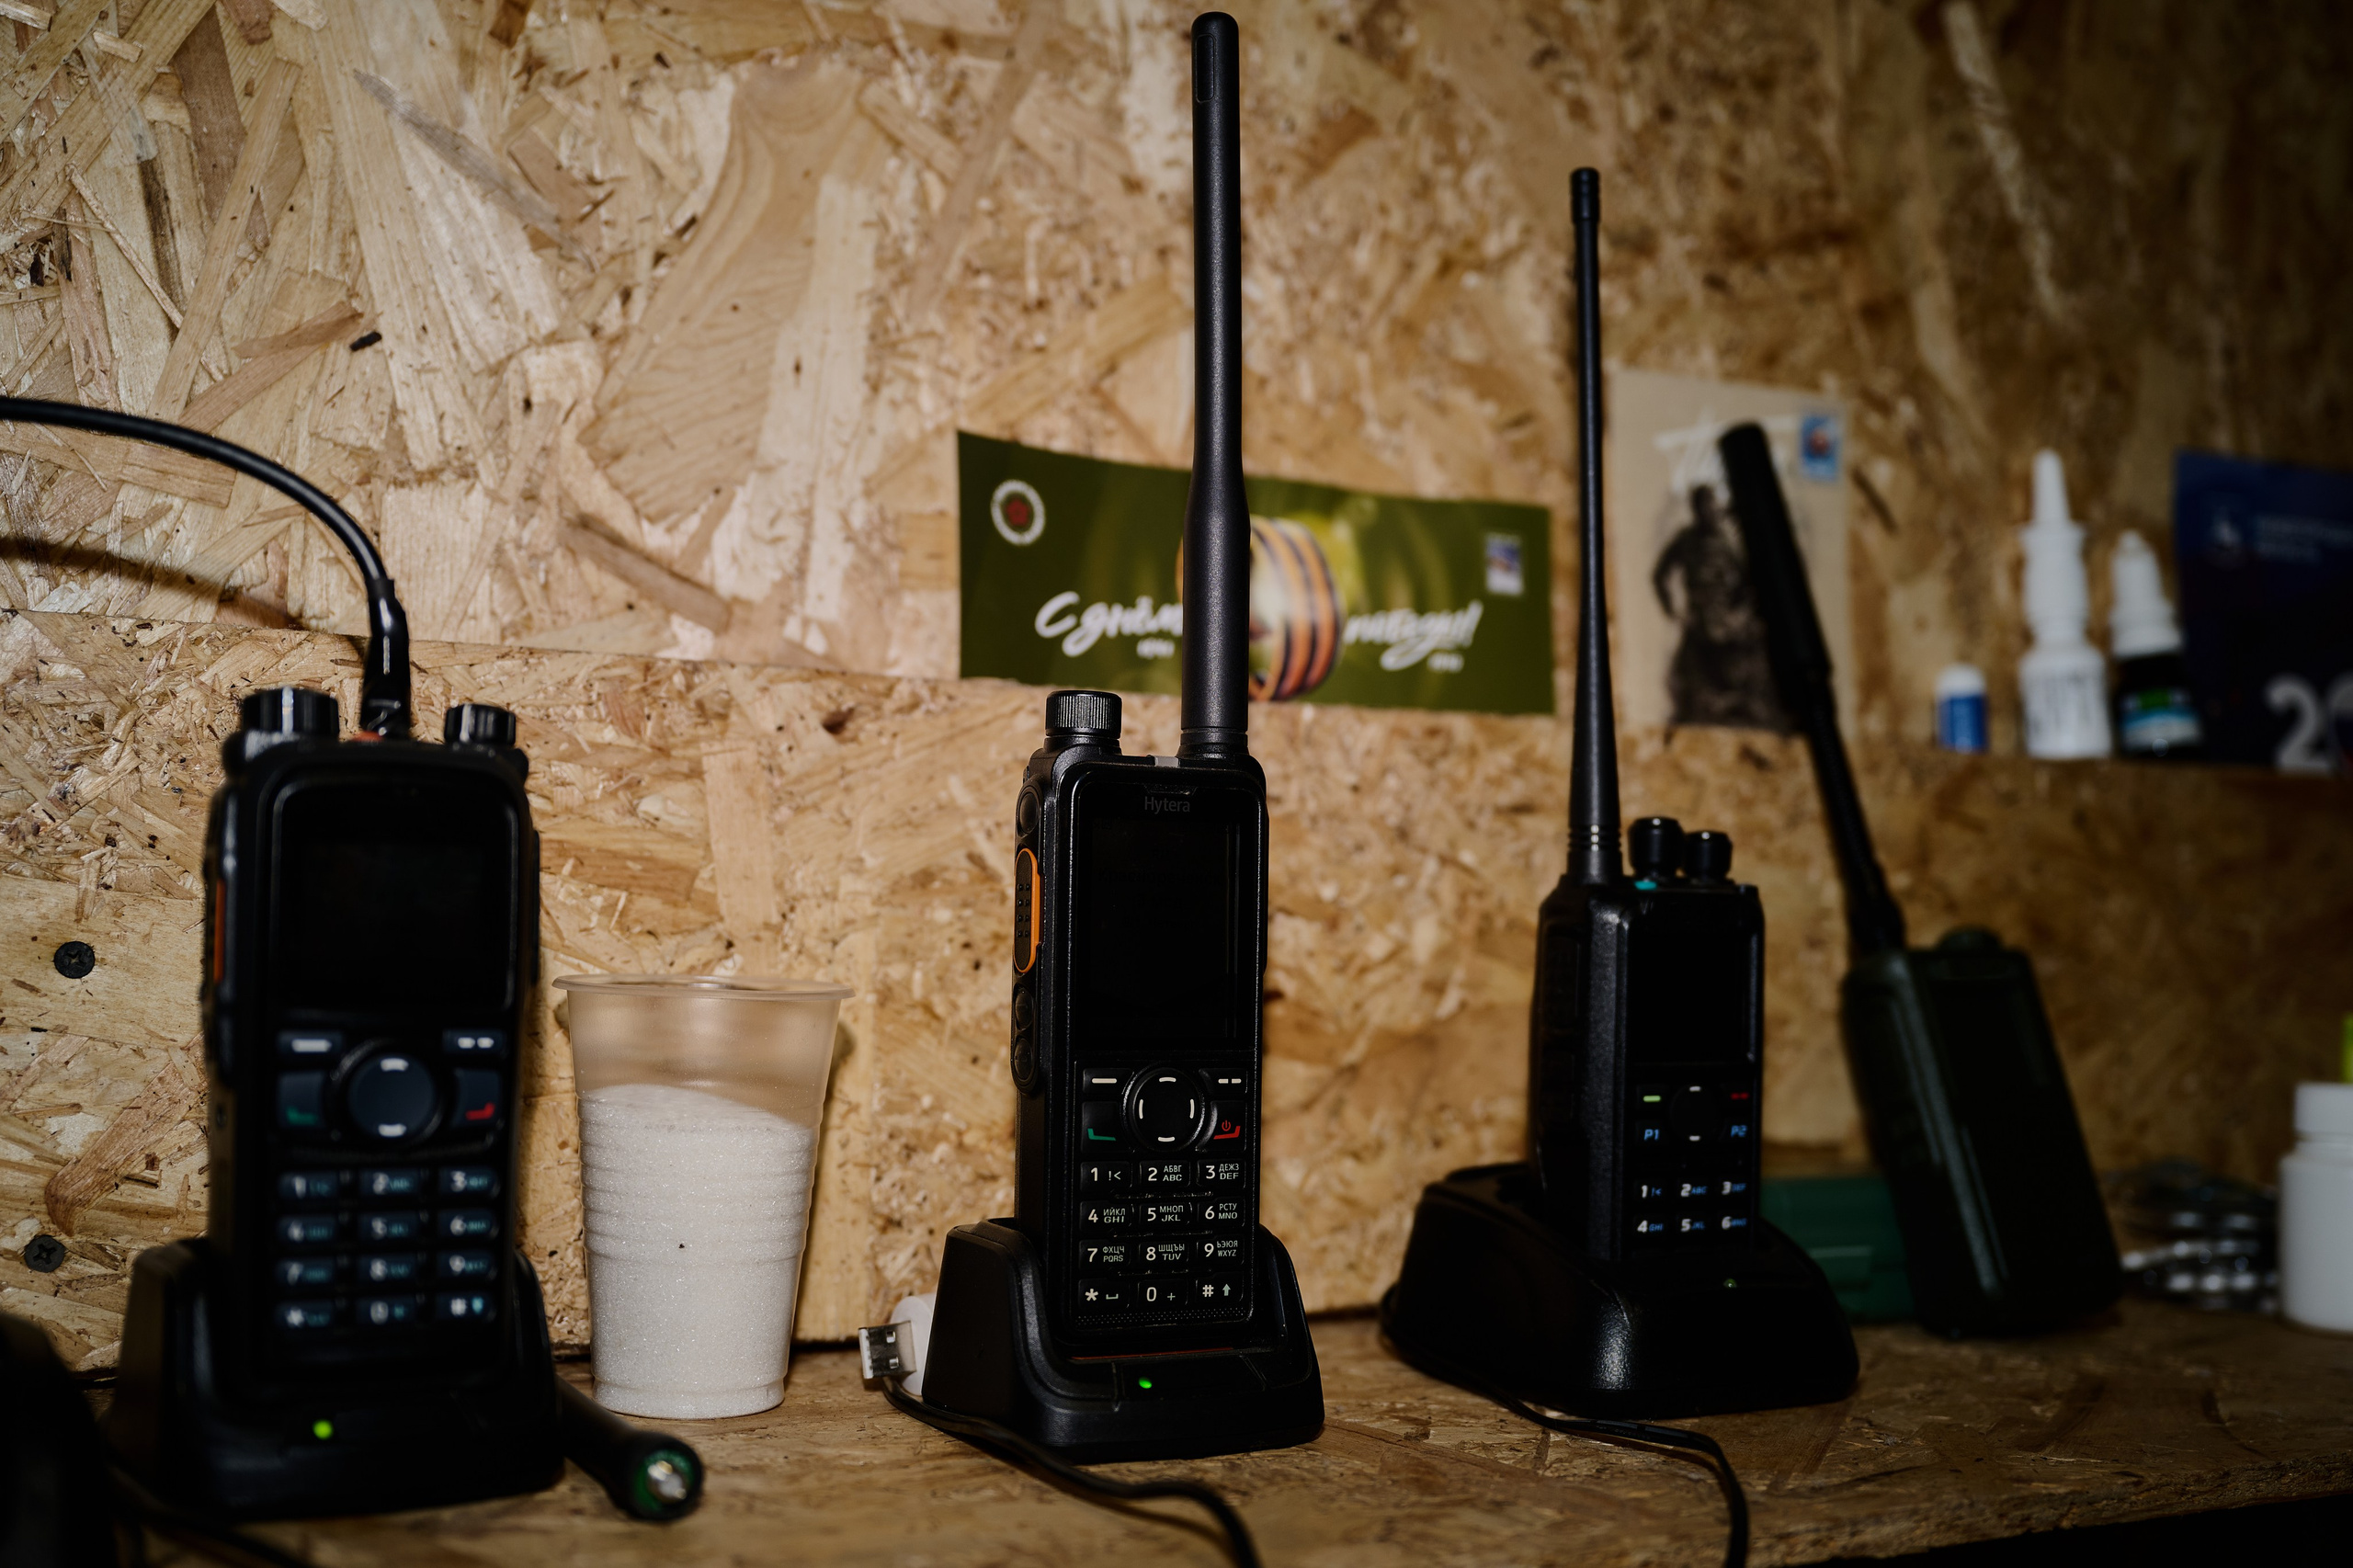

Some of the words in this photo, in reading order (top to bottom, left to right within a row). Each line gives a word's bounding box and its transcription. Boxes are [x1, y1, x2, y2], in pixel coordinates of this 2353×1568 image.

[1144, 796, 1190, 814] Hytera
[1644, 1129, 1660, 1142] P1
[1731, 1125, 1747, 1138] P2
[1091, 1167, 1098, 1181] 1
[1148, 1167, 1157, 1181] 2
[1164, 1165, 1182, 1173] АБВГ
[1163, 1174, 1182, 1182] ABC
[1206, 1165, 1215, 1179] 3
[1220, 1172, 1239, 1180] DEF
[1642, 1185, 1648, 1199] 1
[1681, 1183, 1691, 1198] 2
[1722, 1181, 1732, 1195] 3
[1088, 1209, 1098, 1222] 4
[1147, 1208, 1156, 1221] 5
[1160, 1205, 1183, 1213] МНОП
[1162, 1213, 1181, 1221] JKL
[1205, 1206, 1215, 1220] 6
[1220, 1203, 1237, 1211] РСТУ
[1219, 1211, 1237, 1220] MNO
[1104, 1215, 1125, 1223] GHI
[1681, 1219, 1691, 1233] 5
[1722, 1216, 1732, 1230] 6
[1637, 1220, 1648, 1233] 4
[1087, 1247, 1097, 1262] 7
[1146, 1247, 1156, 1261] 8
[1162, 1253, 1181, 1261] TUV
[1204, 1244, 1214, 1257] 9
[1218, 1248, 1236, 1256] WXYZ
[1146, 1287, 1156, 1301] 0
